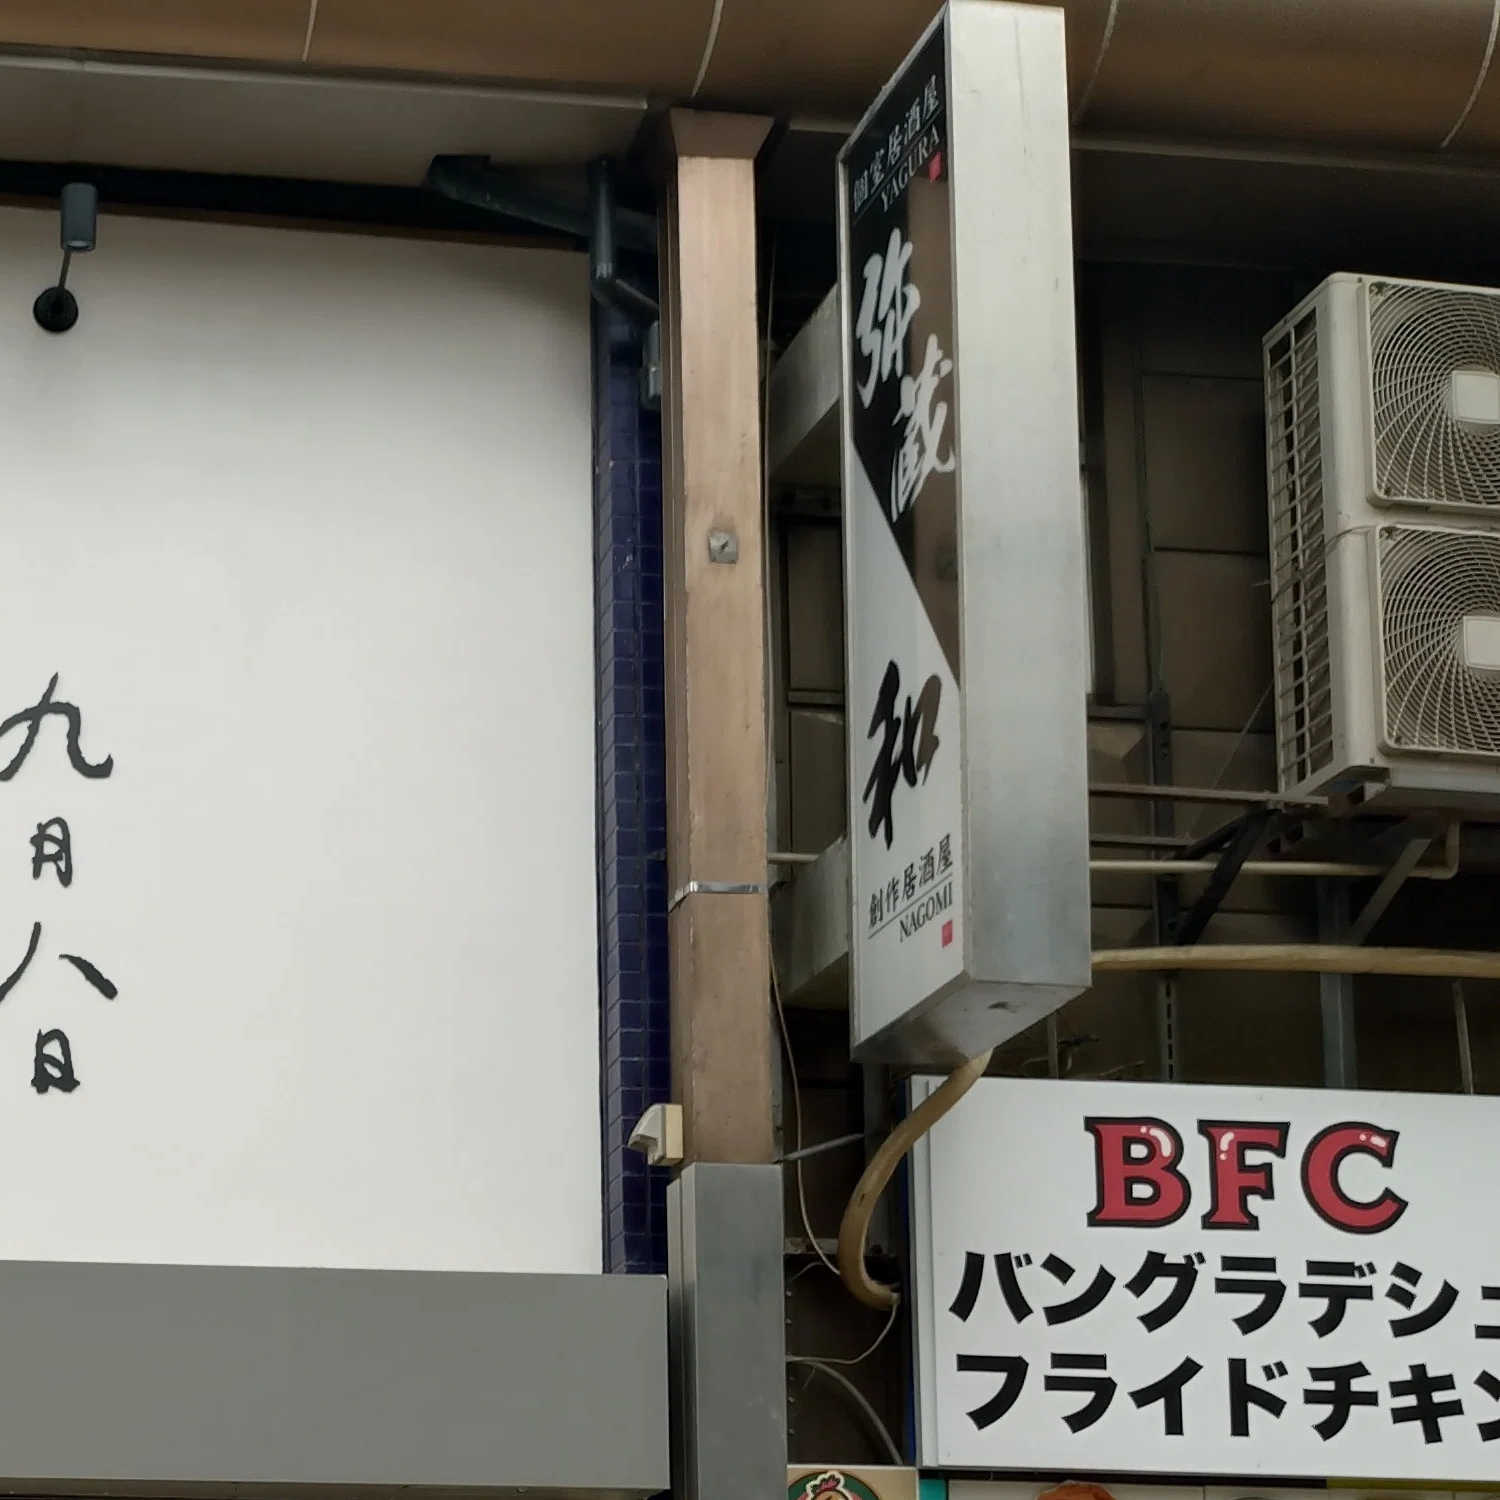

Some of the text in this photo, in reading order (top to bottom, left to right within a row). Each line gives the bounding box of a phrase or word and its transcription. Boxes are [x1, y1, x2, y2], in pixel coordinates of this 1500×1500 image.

[853, 74, 940, 213] 個室居酒屋
[881, 124, 940, 213] YAGURA
[862, 658, 943, 850] 和
[869, 833, 953, 930] 創作居酒屋
[899, 881, 953, 943] NAGOMI
[1083, 1116, 1409, 1235] BFC
